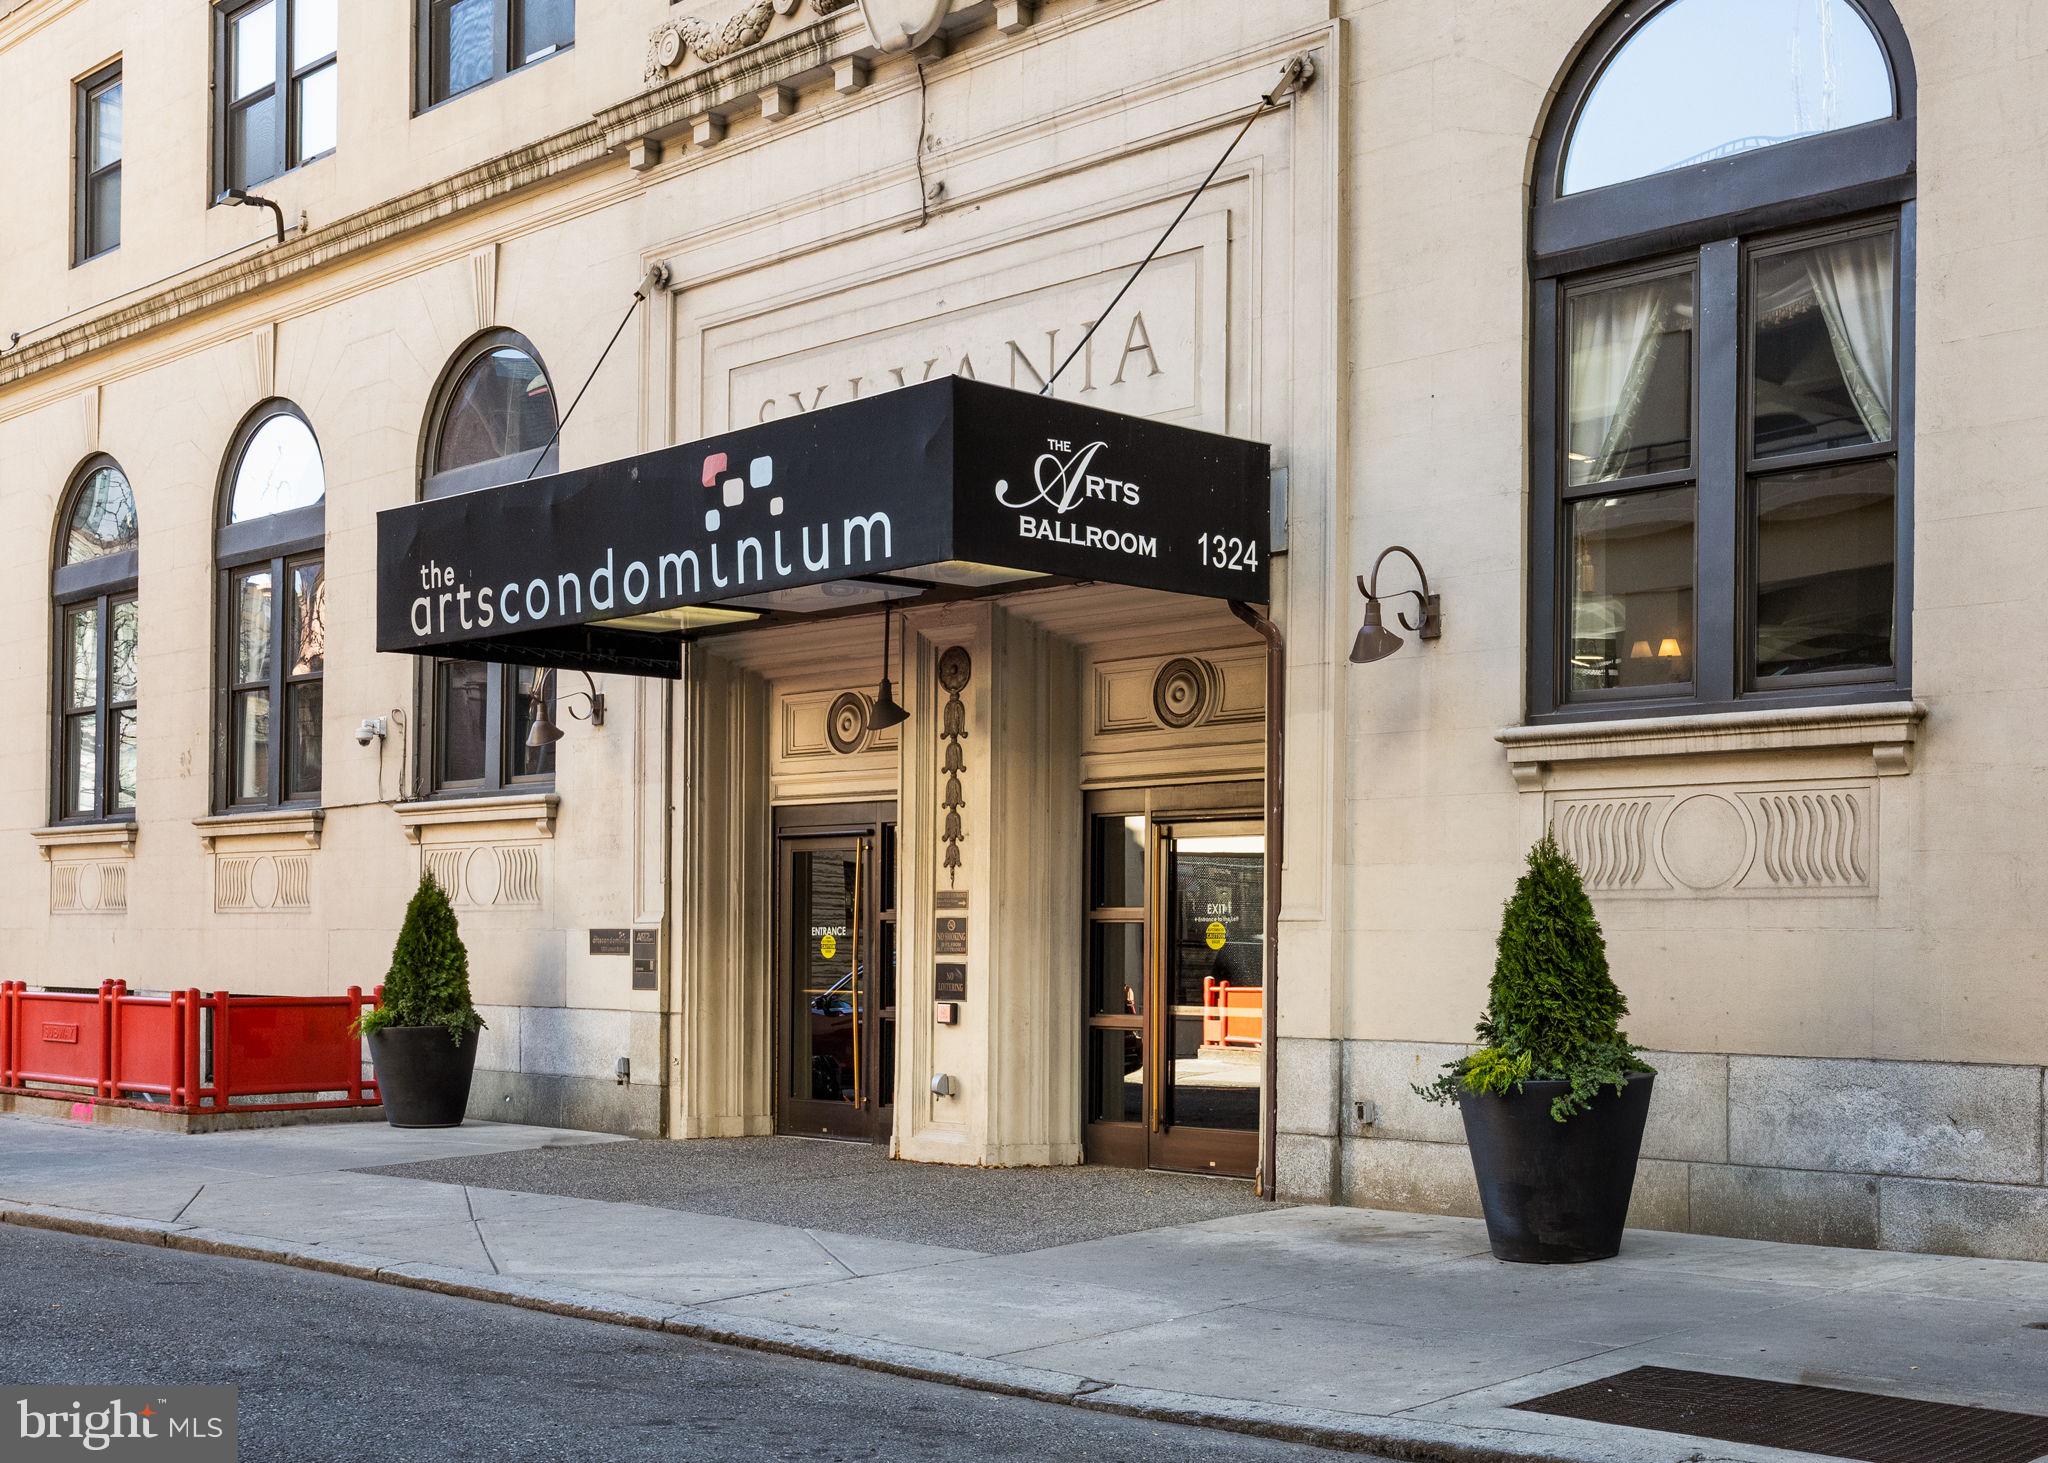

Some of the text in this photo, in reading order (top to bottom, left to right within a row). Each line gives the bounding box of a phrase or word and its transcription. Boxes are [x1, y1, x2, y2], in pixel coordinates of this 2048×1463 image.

[1047, 438, 1072, 453] THE
[1018, 514, 1158, 558] BALLROOM
[1197, 532, 1259, 573] 1324
[420, 559, 455, 591] the
[1207, 903, 1226, 915] EXIT
[811, 926, 847, 936] ENTRANCE
